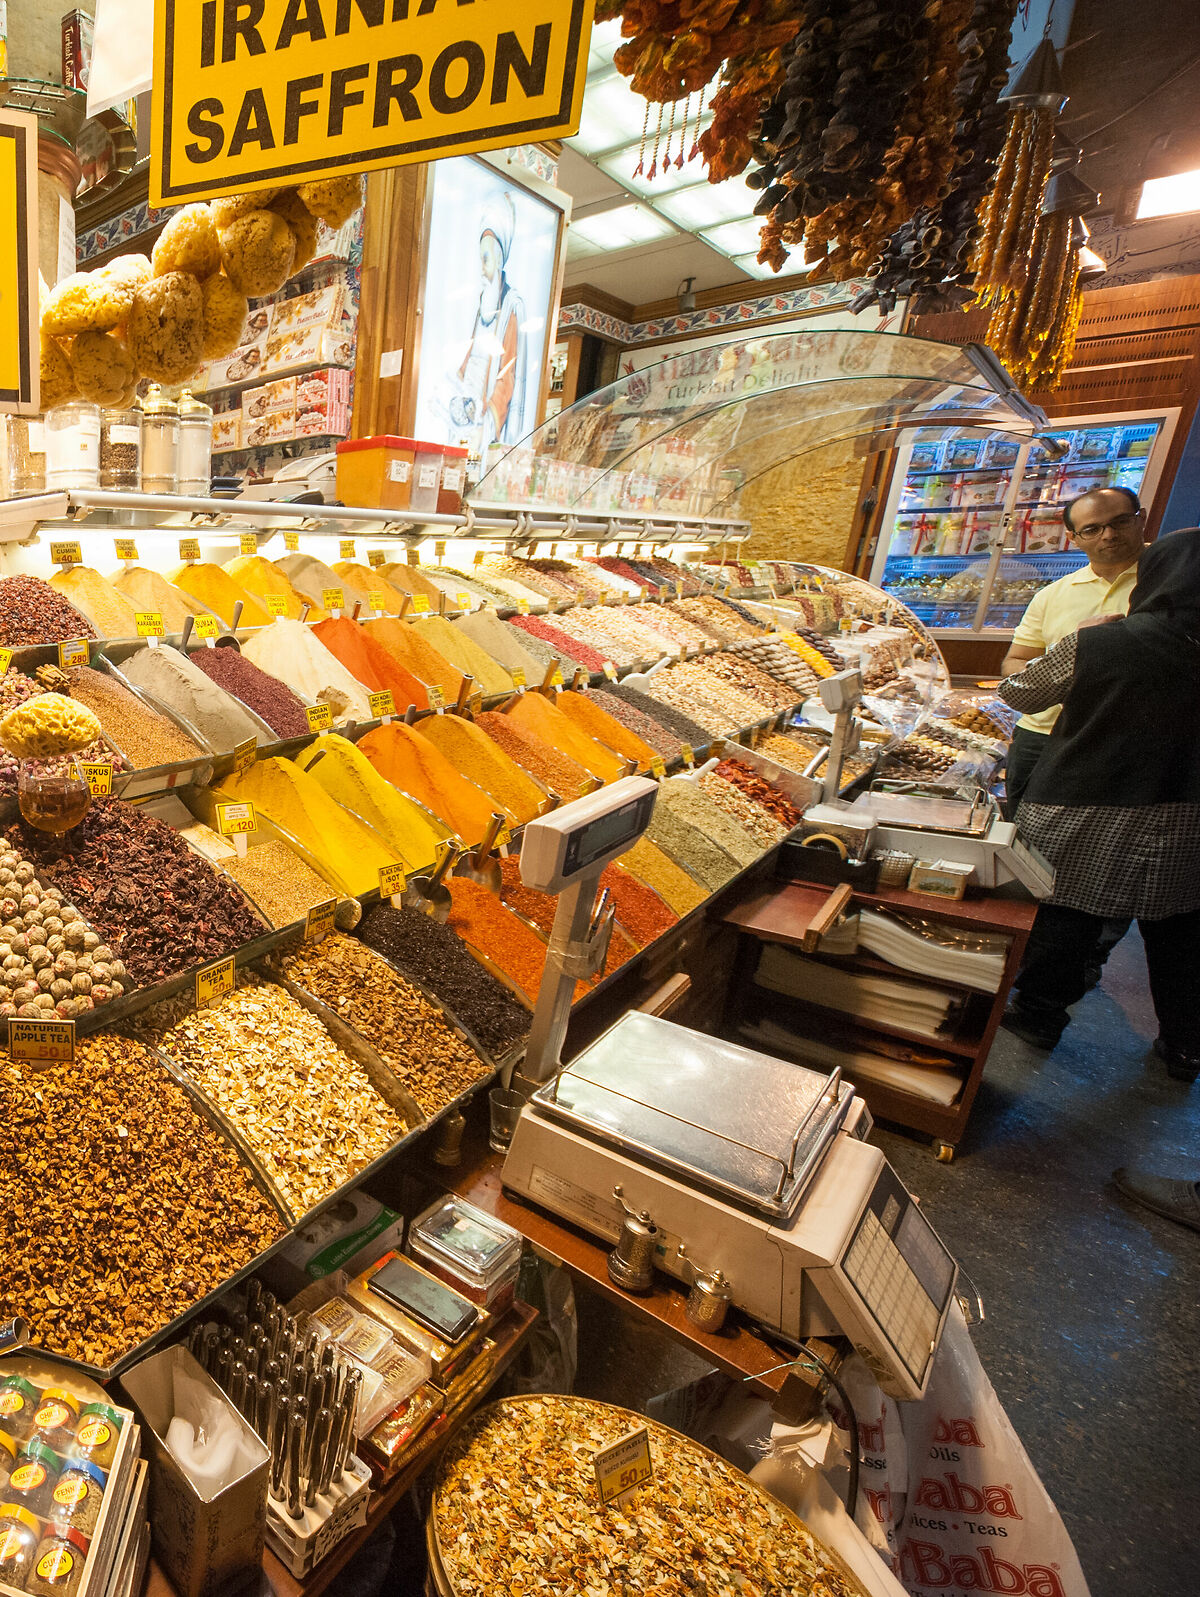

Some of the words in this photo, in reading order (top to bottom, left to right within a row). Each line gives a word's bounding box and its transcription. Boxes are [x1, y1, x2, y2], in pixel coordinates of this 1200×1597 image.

[200, 0, 487, 69] IRAN
[184, 22, 553, 164] SAFFRON
[61, 555, 73, 563] 40
[153, 627, 162, 635] 70
[72, 654, 87, 664] 280
[310, 706, 328, 715] INDIAN
[310, 713, 329, 722] CURRY
[319, 720, 327, 728] 50
[72, 768, 109, 776] HISKUS
[92, 784, 107, 793] 60
[237, 821, 254, 831] 120
[201, 963, 231, 982] ORANGE
[208, 975, 224, 986] TEA
[16, 1024, 68, 1032] NATUREL
[13, 1033, 46, 1041] APPLE
[47, 1034, 70, 1043] TEA
[38, 1046, 60, 1058] 50
[384, 1210, 395, 1218] L
[620, 1468, 638, 1487] 50
[57, 1485, 84, 1498] FENNL
[964, 1520, 1008, 1537] Teas
[42, 1554, 67, 1570] CUMN
